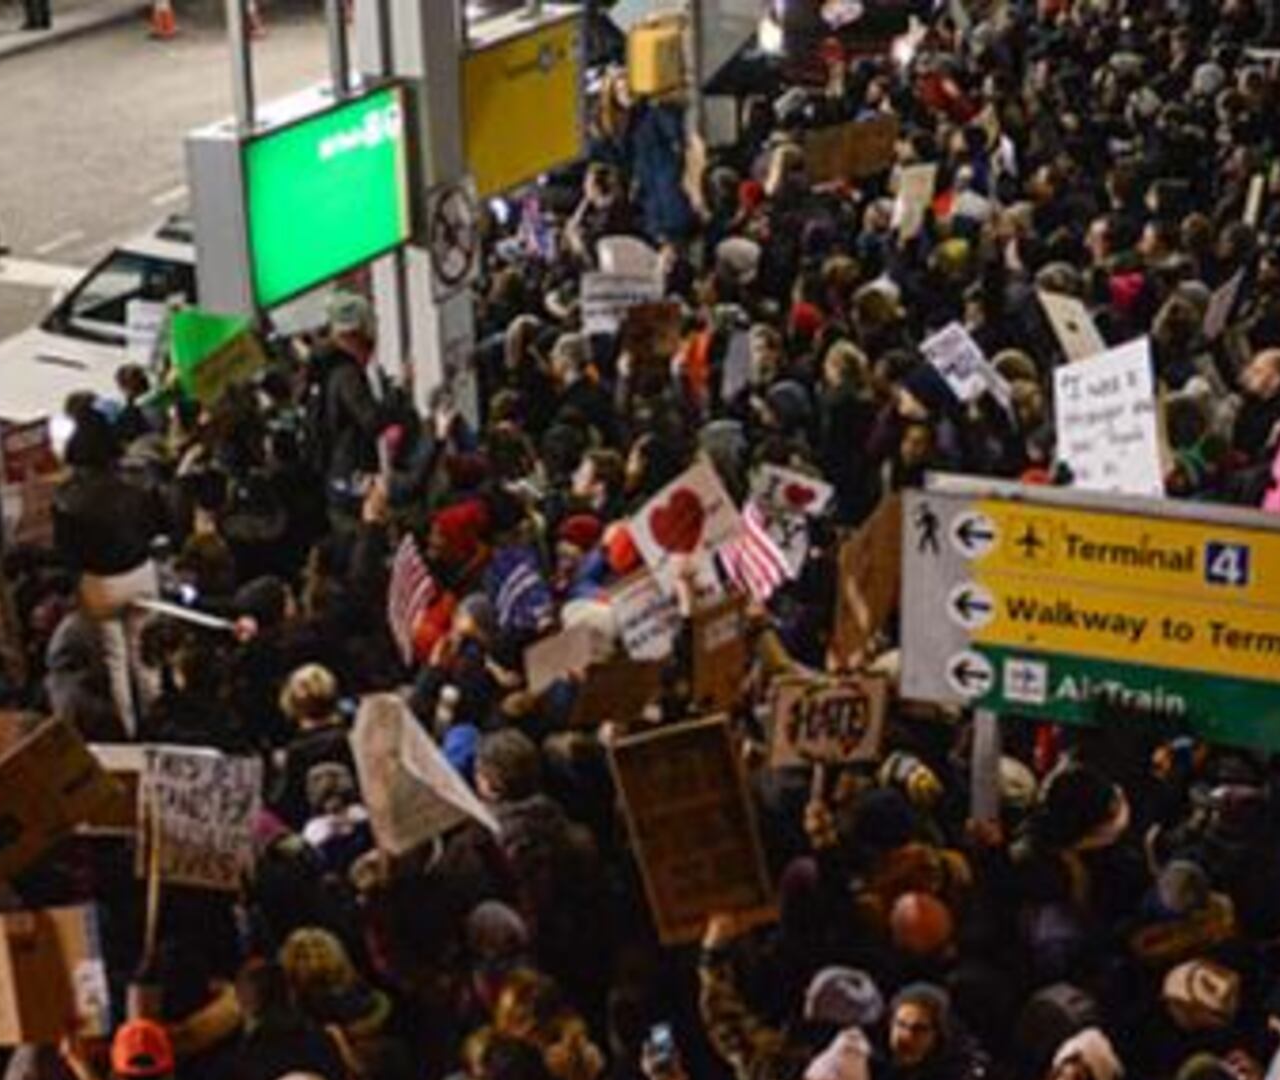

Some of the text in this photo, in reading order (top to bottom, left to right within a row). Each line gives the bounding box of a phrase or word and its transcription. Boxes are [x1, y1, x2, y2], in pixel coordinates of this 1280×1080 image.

[1065, 530, 1243, 582] Terminal 4
[1006, 595, 1149, 643] Walkway
[1161, 617, 1195, 643] to
